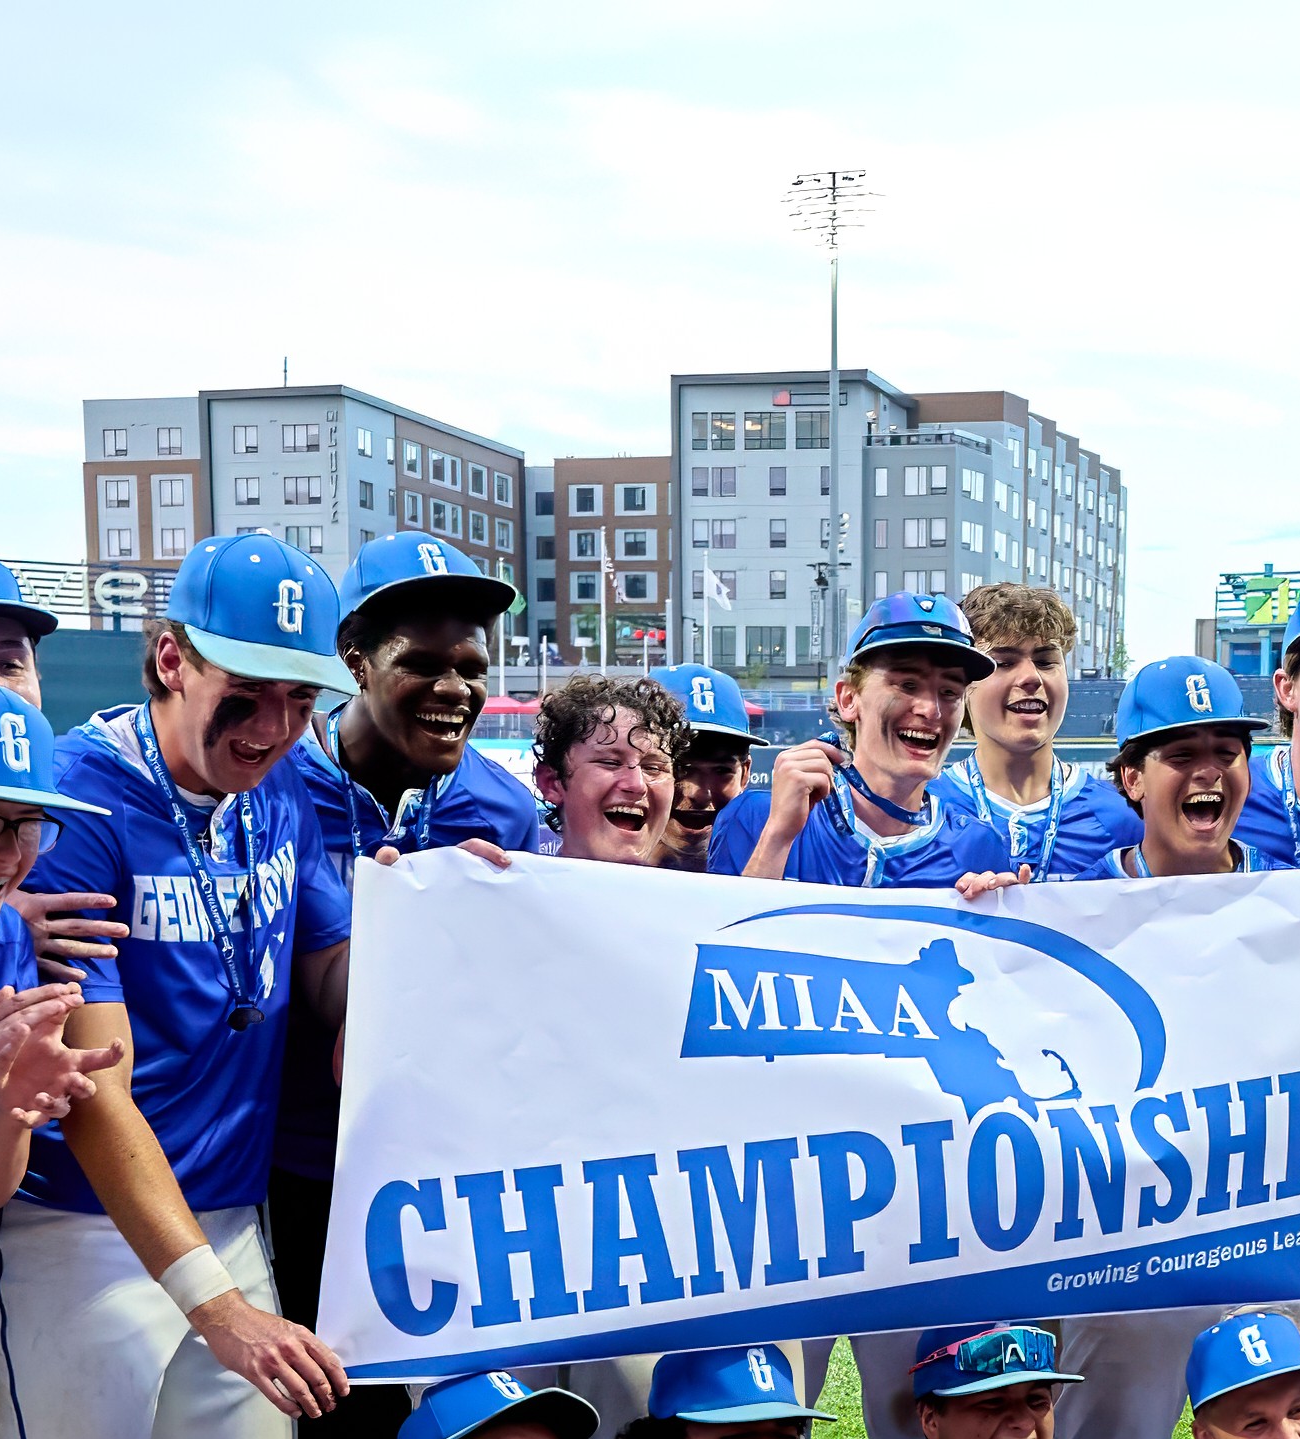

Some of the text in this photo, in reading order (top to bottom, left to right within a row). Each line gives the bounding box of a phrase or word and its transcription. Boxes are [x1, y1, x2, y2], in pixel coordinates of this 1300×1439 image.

[417, 543, 450, 577] G
[272, 579, 305, 636] G
[690, 676, 716, 715] G
[1185, 672, 1213, 715] G
[705, 966, 939, 1042] MIAA
[1046, 1260, 1141, 1293] Growing
[1145, 1236, 1268, 1276] Courageous
[1238, 1324, 1273, 1368] G
[487, 1371, 526, 1401] G
[747, 1346, 777, 1393] G
